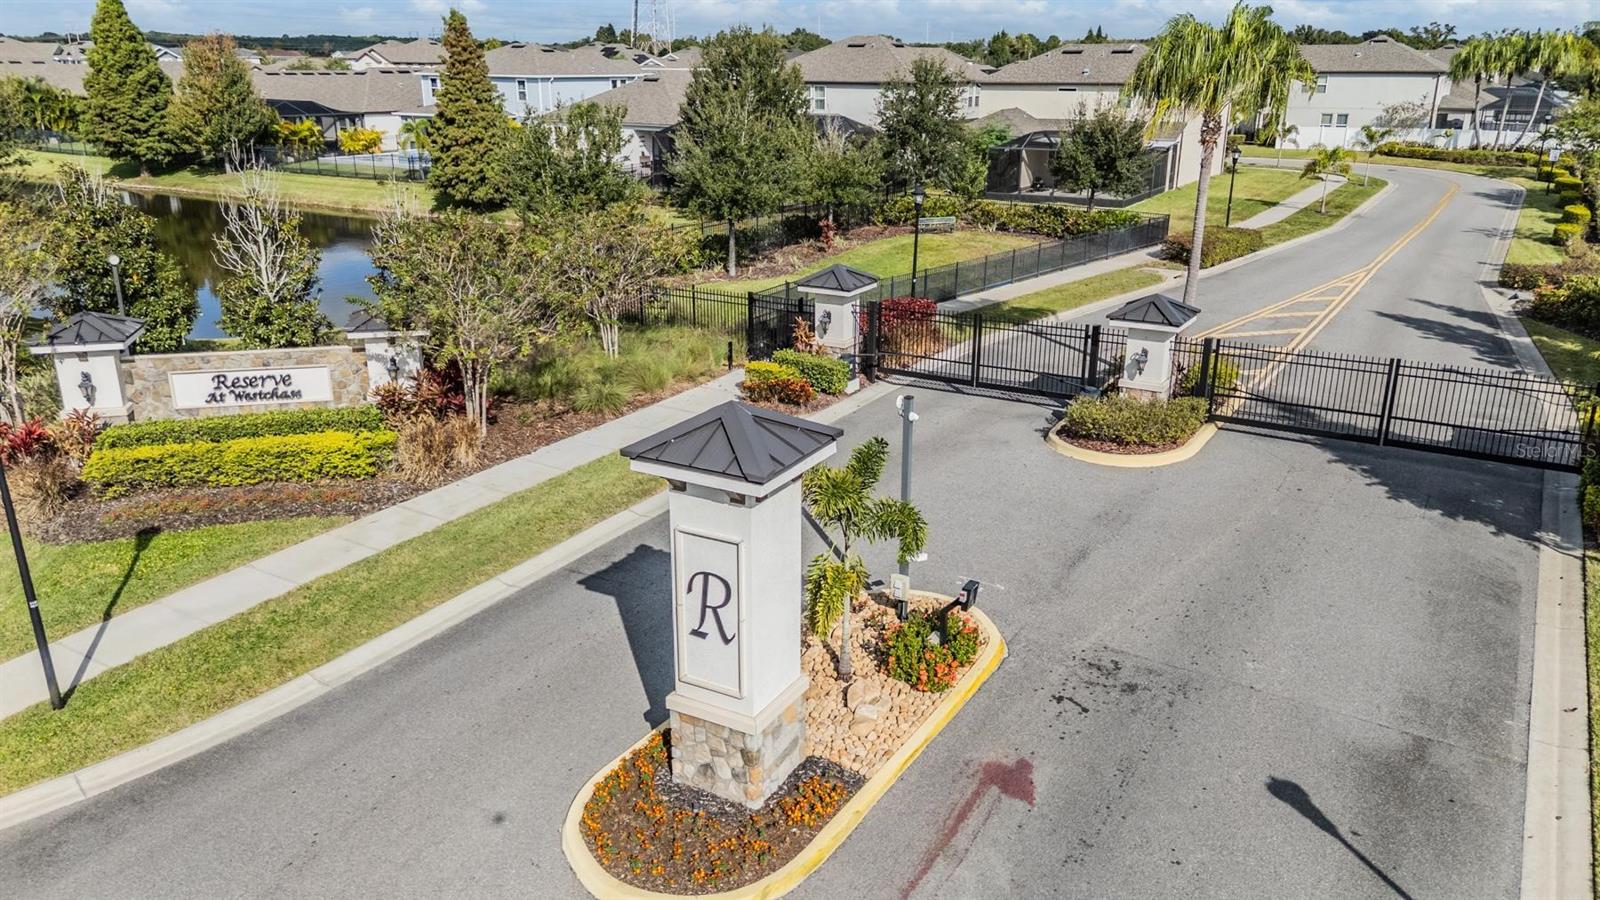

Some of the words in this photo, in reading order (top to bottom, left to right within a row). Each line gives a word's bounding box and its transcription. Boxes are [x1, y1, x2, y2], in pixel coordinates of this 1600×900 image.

[212, 374, 292, 390] Reserve
[205, 392, 226, 404] At
[686, 571, 736, 645] R
